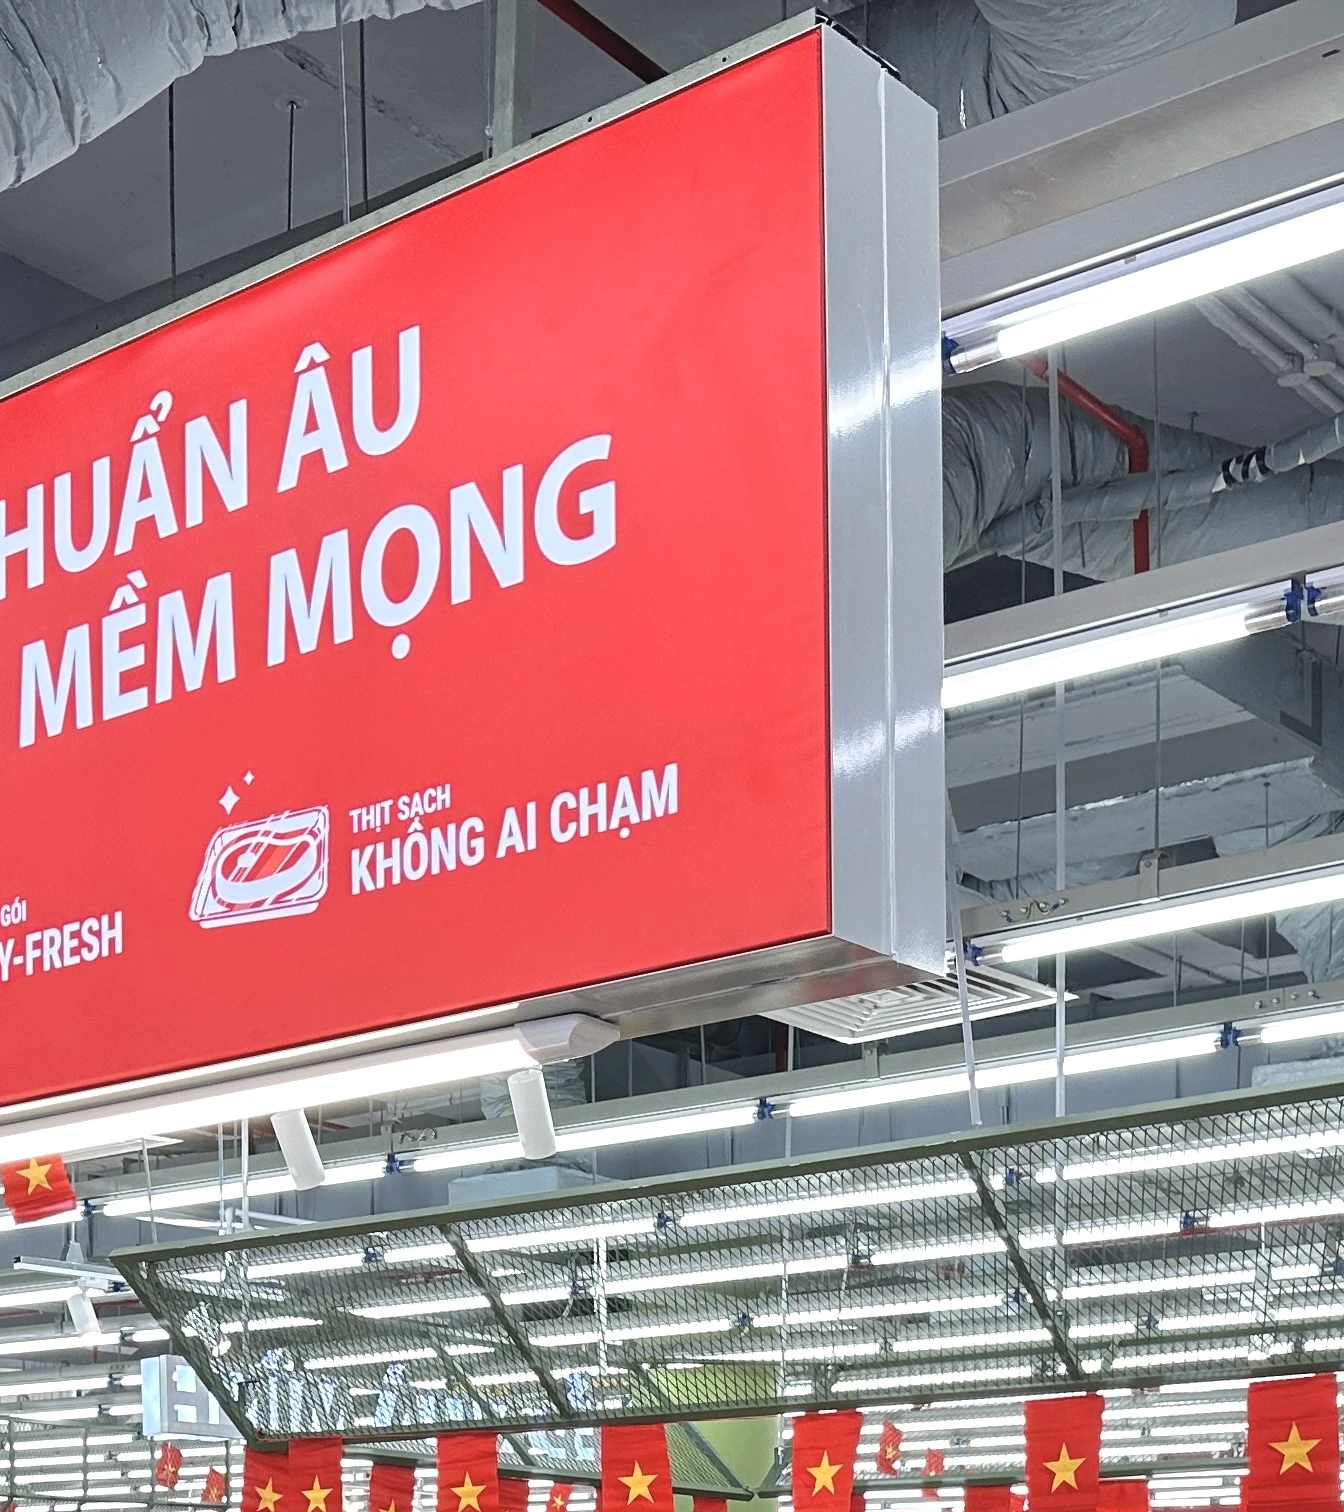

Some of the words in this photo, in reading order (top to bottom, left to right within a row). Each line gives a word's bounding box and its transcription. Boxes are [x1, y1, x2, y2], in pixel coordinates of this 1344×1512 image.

[276, 325, 421, 493] ÂU
[19, 570, 236, 748] MỀM
[266, 434, 617, 666] MỌNG
[349, 801, 393, 832] THỊT
[398, 783, 451, 823] SẠCH
[350, 820, 485, 895] KHÔNG
[497, 799, 537, 856] AI
[549, 762, 680, 840] CHẠM
[0, 899, 27, 931] GÓI
